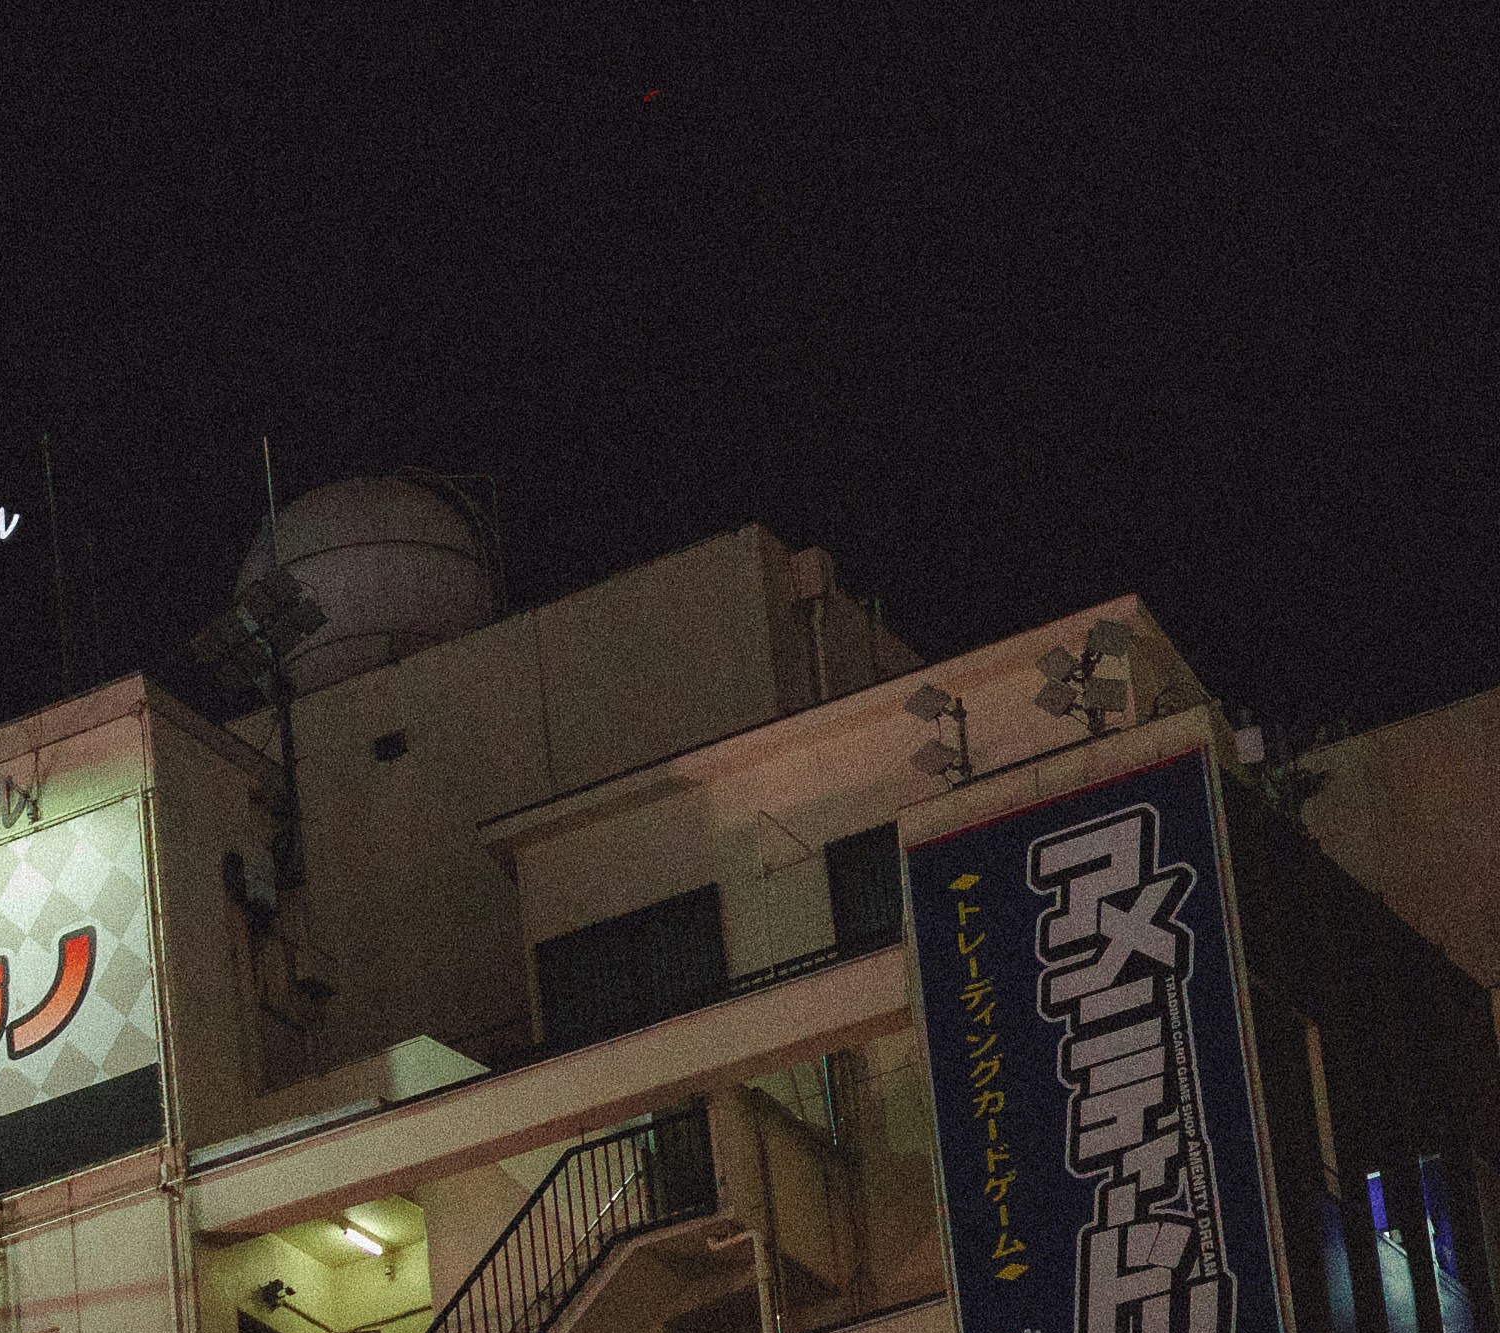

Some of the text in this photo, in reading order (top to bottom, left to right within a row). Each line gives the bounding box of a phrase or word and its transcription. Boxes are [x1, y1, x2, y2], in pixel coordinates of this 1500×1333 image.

[1165, 975, 1183, 1029] TRADING
[1173, 1032, 1188, 1064] CARD
[957, 901, 1026, 1260] トレーディングカードゲーム
[1177, 1067, 1192, 1101] GAME
[1182, 1104, 1196, 1137] SHOP
[1187, 1141, 1208, 1211] AMENITY
